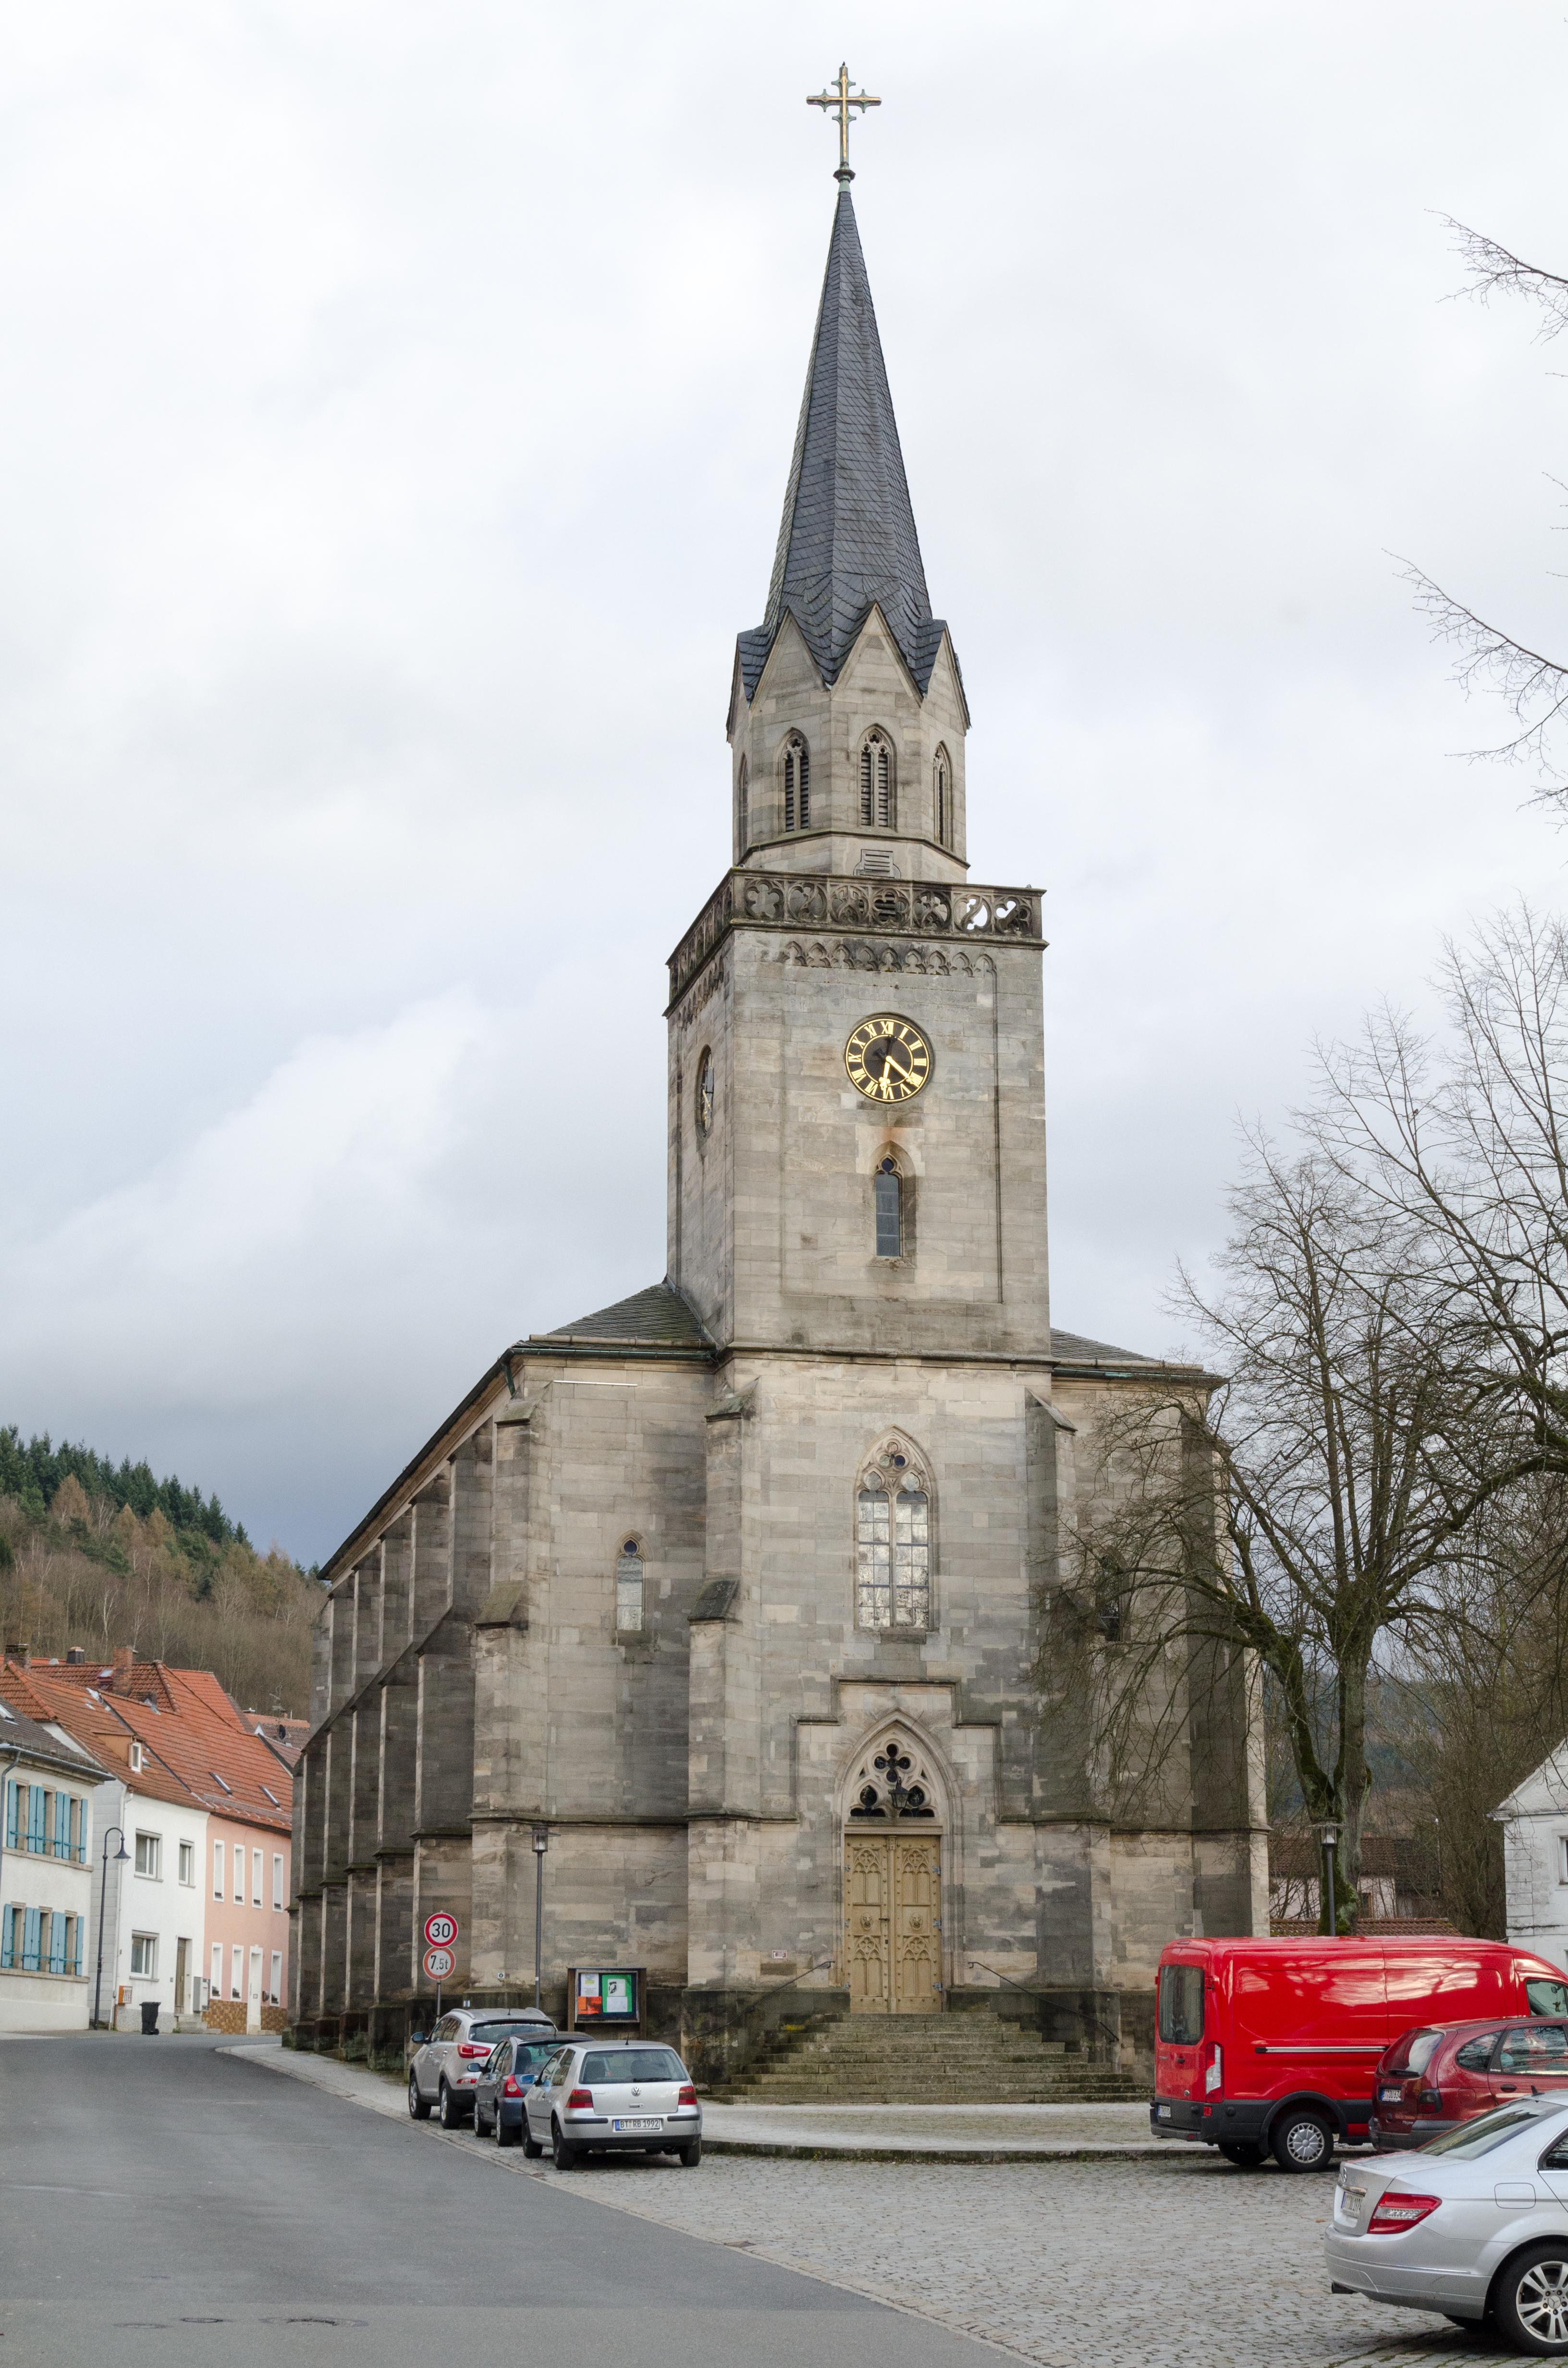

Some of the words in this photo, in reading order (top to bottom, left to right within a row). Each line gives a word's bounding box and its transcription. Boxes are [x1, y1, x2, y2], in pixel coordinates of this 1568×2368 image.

[864, 1024, 877, 1038] XI
[880, 1021, 894, 1035] XII
[899, 1027, 909, 1039] I
[851, 1036, 866, 1049] X
[909, 1040, 923, 1051] II
[848, 1052, 861, 1062] IX
[914, 1058, 927, 1066] III
[851, 1068, 867, 1083] VIII
[865, 1080, 878, 1096] VII
[882, 1086, 894, 1099] VI
[900, 1083, 912, 1097] V
[432, 1923, 450, 1937] 30
[620, 2120, 628, 2128] BT
